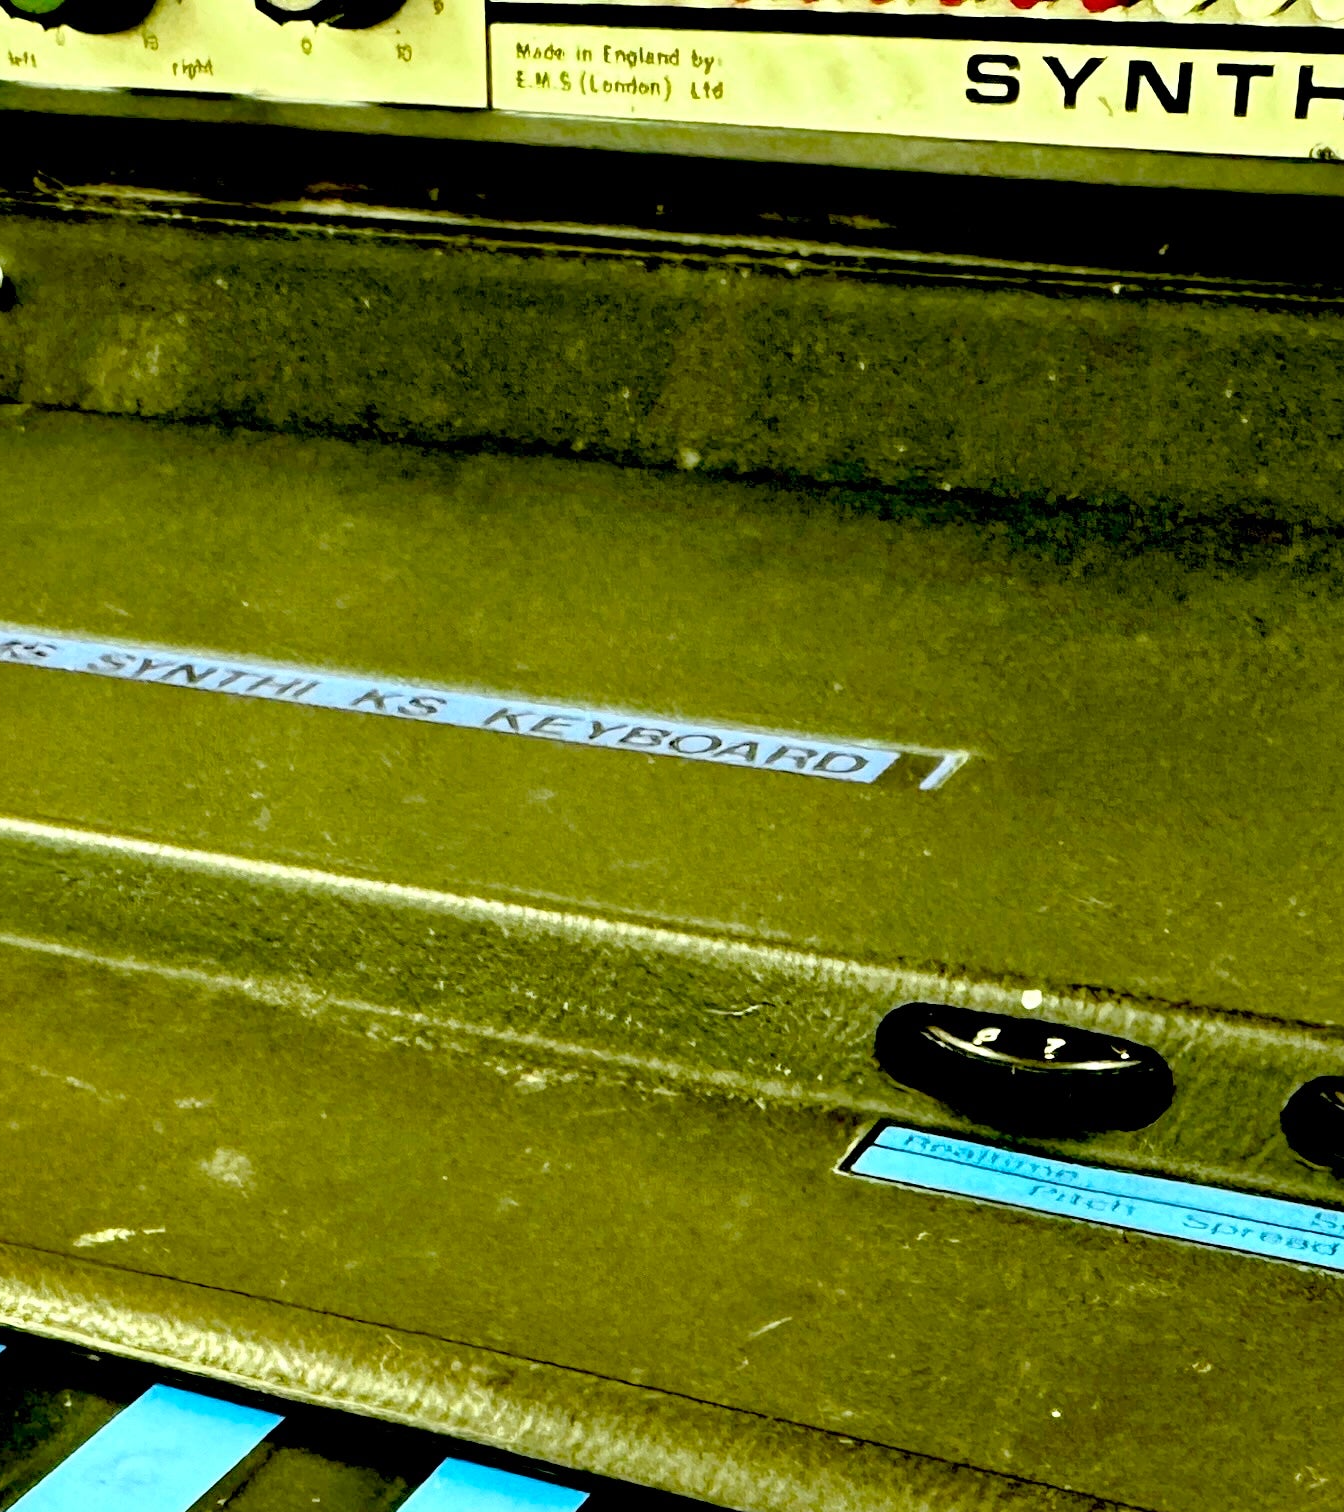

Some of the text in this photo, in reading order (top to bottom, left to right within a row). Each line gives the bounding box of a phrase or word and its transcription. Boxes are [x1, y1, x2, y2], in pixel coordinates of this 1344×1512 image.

[515, 41, 565, 61] Made
[575, 45, 593, 62] in
[602, 44, 680, 69] England
[579, 70, 672, 102] (London)
[86, 652, 323, 699] SYNTHI
[350, 687, 448, 716] KS
[482, 707, 870, 774] KEYBOARD
[1181, 1213, 1342, 1257] Spread
